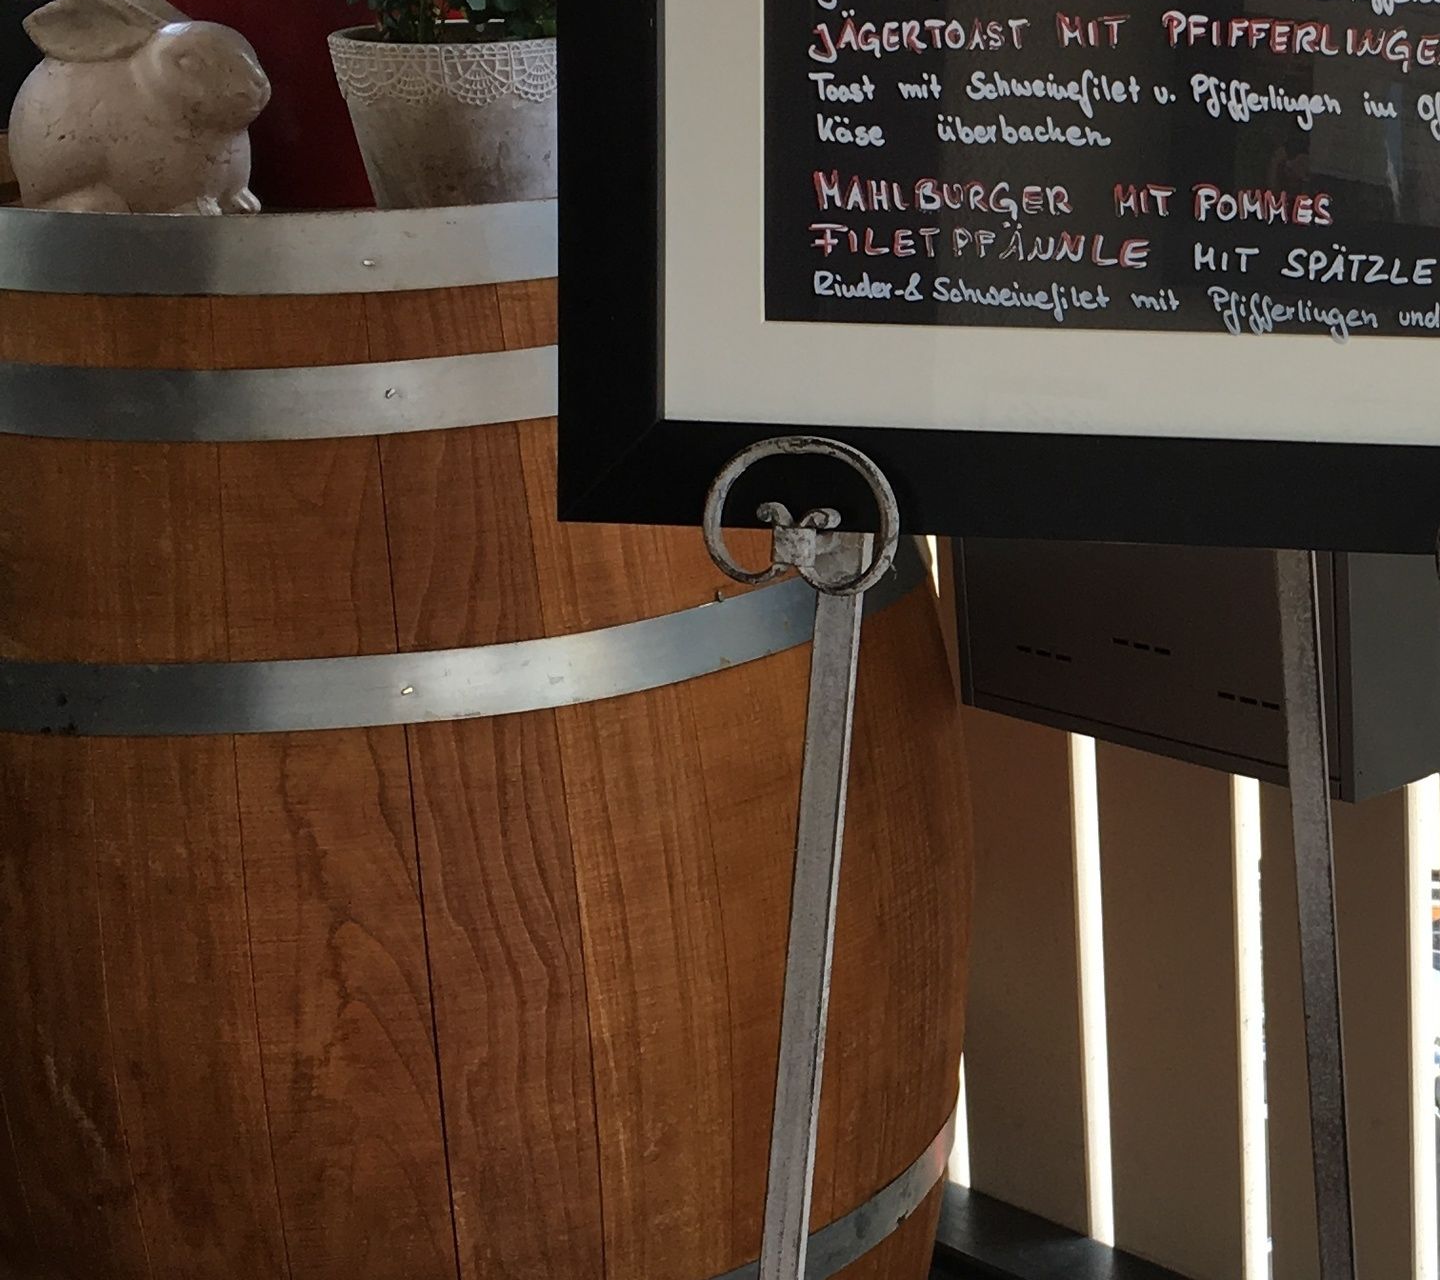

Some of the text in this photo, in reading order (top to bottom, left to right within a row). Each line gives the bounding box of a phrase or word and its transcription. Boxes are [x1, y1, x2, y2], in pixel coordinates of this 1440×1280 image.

[808, 9, 1031, 63] JÄGERTOAST
[1055, 12, 1130, 48] MIT
[808, 72, 876, 103] Toast
[898, 73, 942, 101] mit
[966, 69, 1141, 118] Schweinefilet
[1190, 73, 1341, 131] Pfifferlingen
[1363, 91, 1398, 119] im
[816, 113, 1111, 147] Käse überbacken
[1113, 182, 1177, 217] MIT
[1192, 184, 1333, 225] POMMES
[1194, 242, 1259, 272] MIT
[1280, 243, 1438, 285] SPÄTZLE
[933, 280, 1110, 321] Schweinefilet
[1131, 289, 1180, 311] mit
[1207, 286, 1378, 344] Pfifferlingen
[1399, 303, 1440, 328] und
